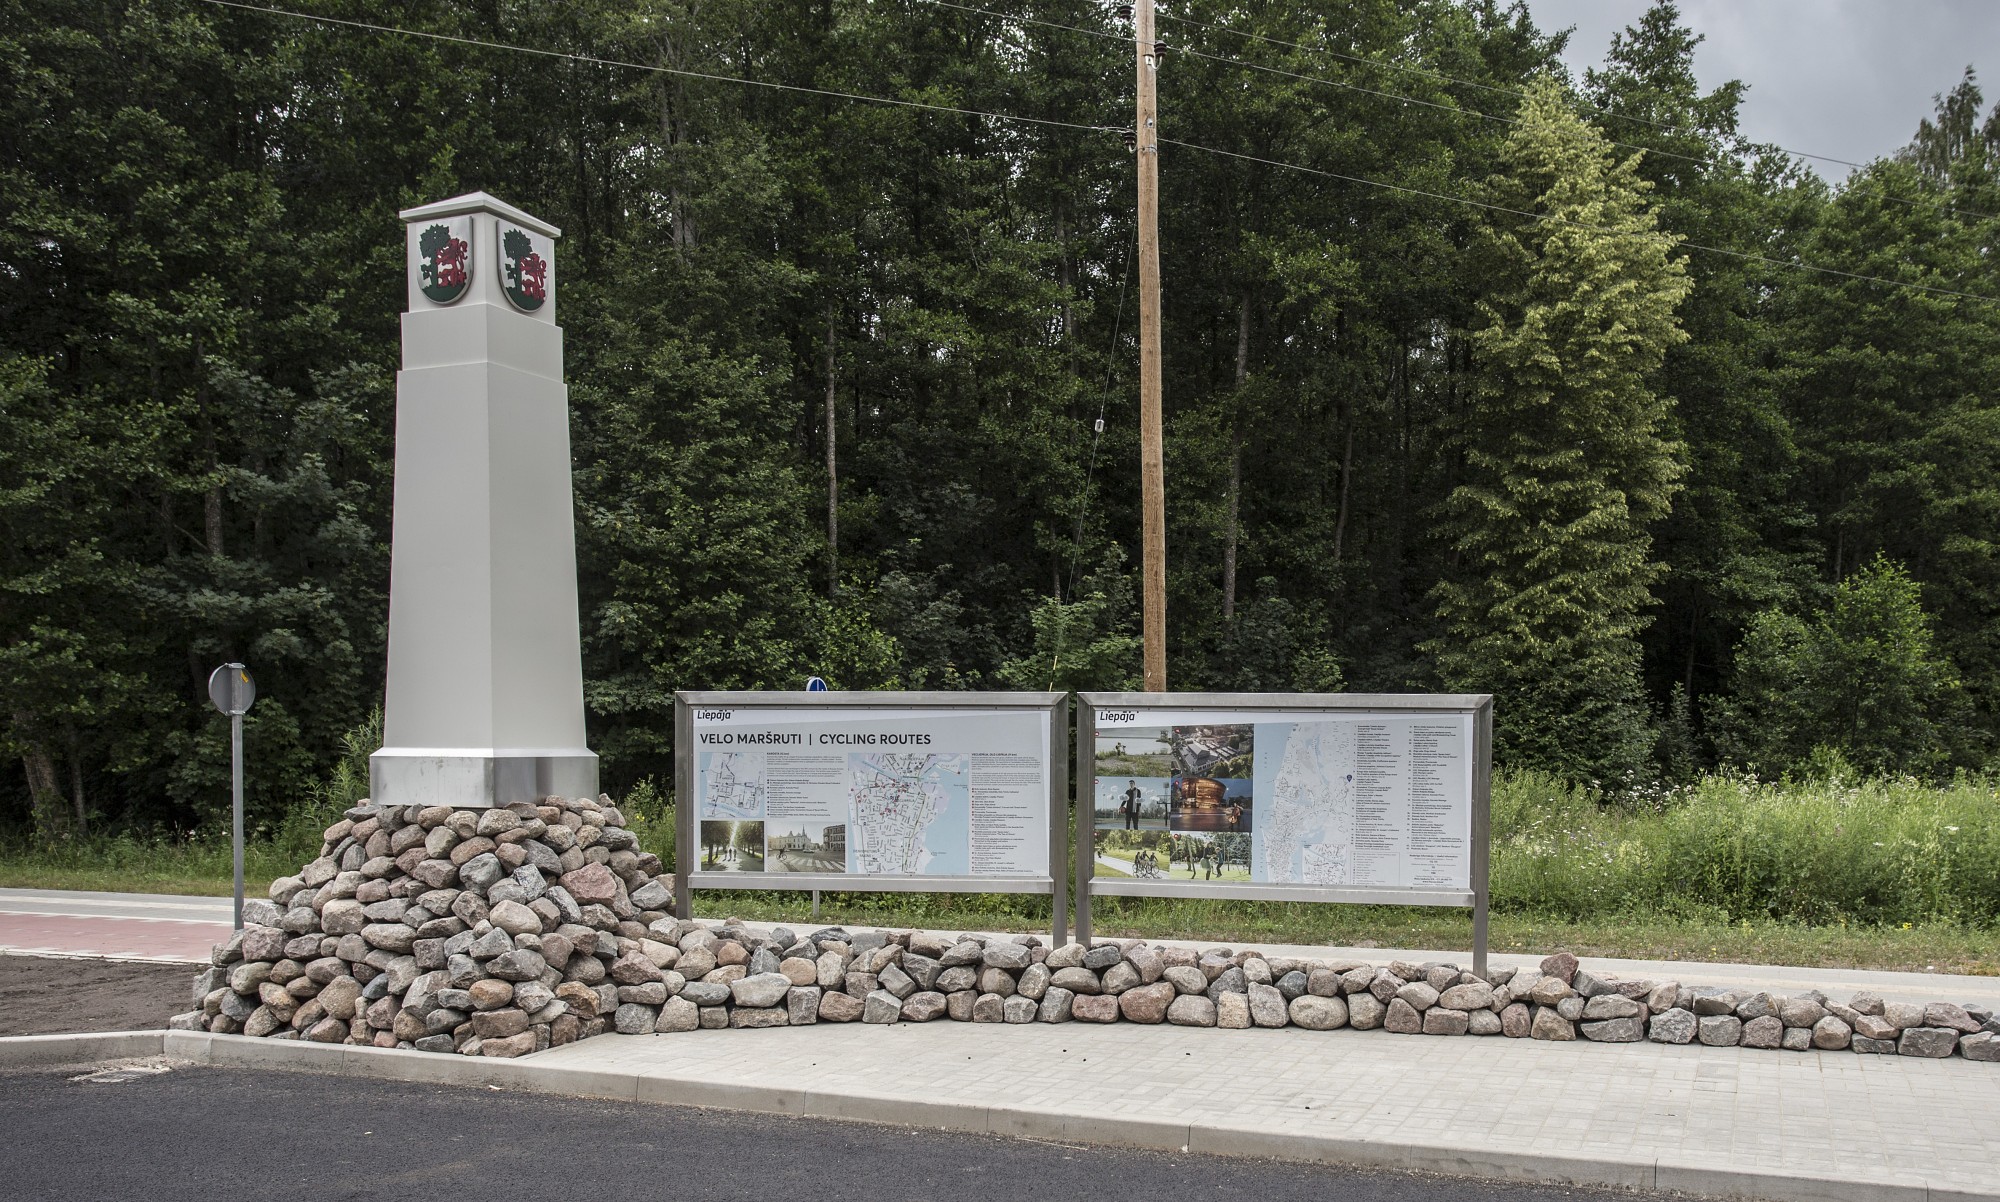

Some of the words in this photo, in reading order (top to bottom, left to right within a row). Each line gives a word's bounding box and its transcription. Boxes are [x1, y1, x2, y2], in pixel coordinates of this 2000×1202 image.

[699, 733, 734, 745] VELO
[737, 730, 802, 745] MARŠRUTI
[819, 733, 876, 745] CYCLING
[879, 733, 932, 745] ROUTES
